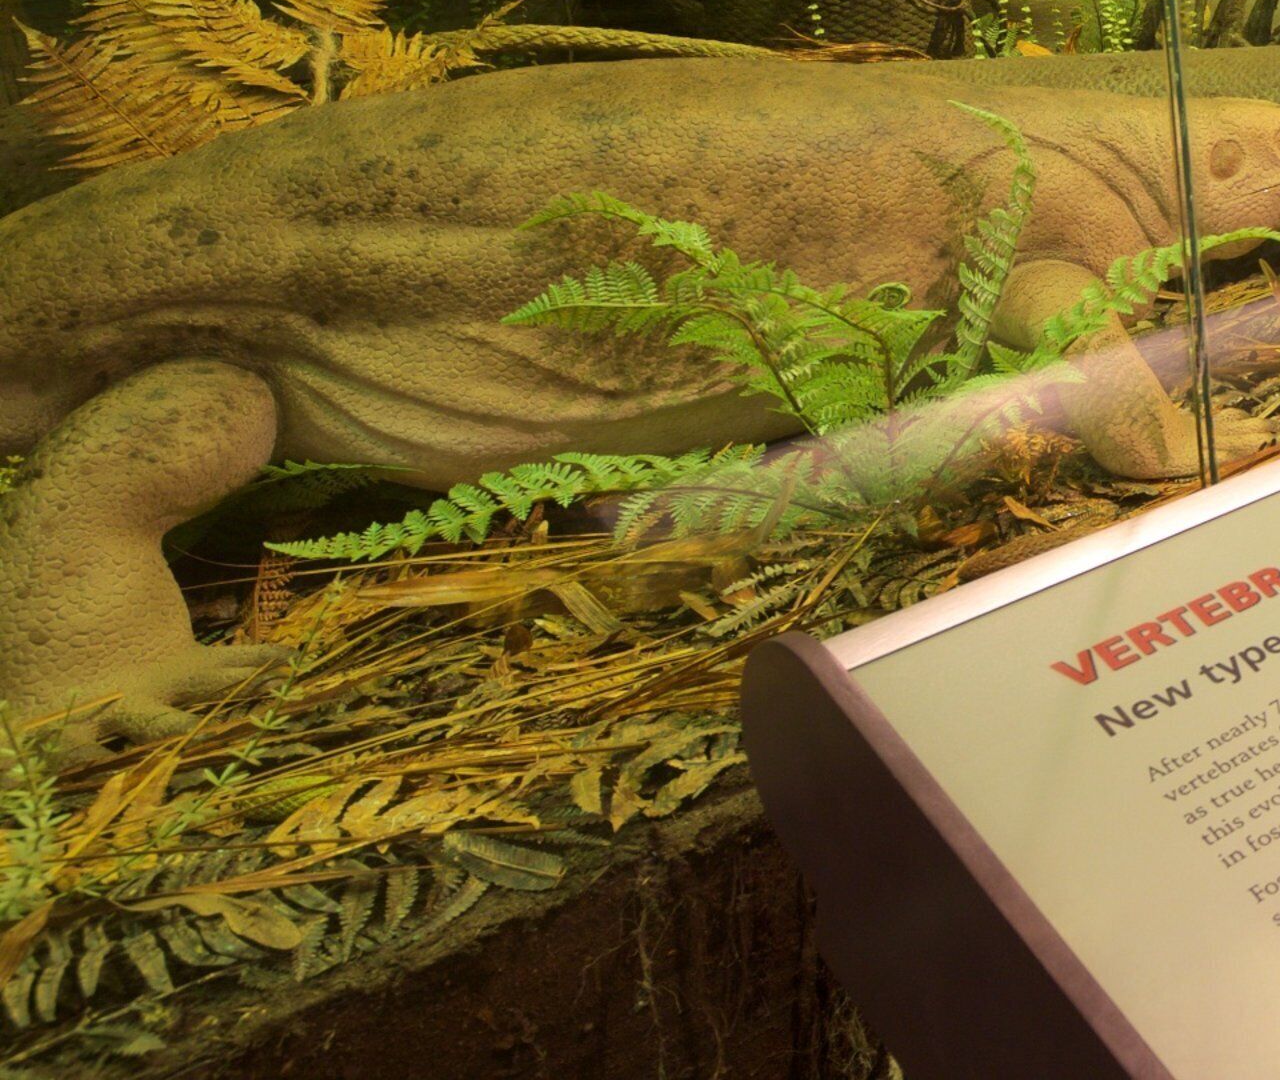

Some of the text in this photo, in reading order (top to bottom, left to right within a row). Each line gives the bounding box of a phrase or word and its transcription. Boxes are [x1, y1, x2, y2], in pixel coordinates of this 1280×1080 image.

[1094, 679, 1193, 737] New
[1148, 746, 1202, 782] After
[1206, 710, 1268, 751] nearly
[1163, 734, 1279, 802] vertebrates
[1183, 806, 1208, 825] as
[1210, 778, 1256, 809] true
[1200, 816, 1245, 846] this
[1217, 849, 1247, 869] in
